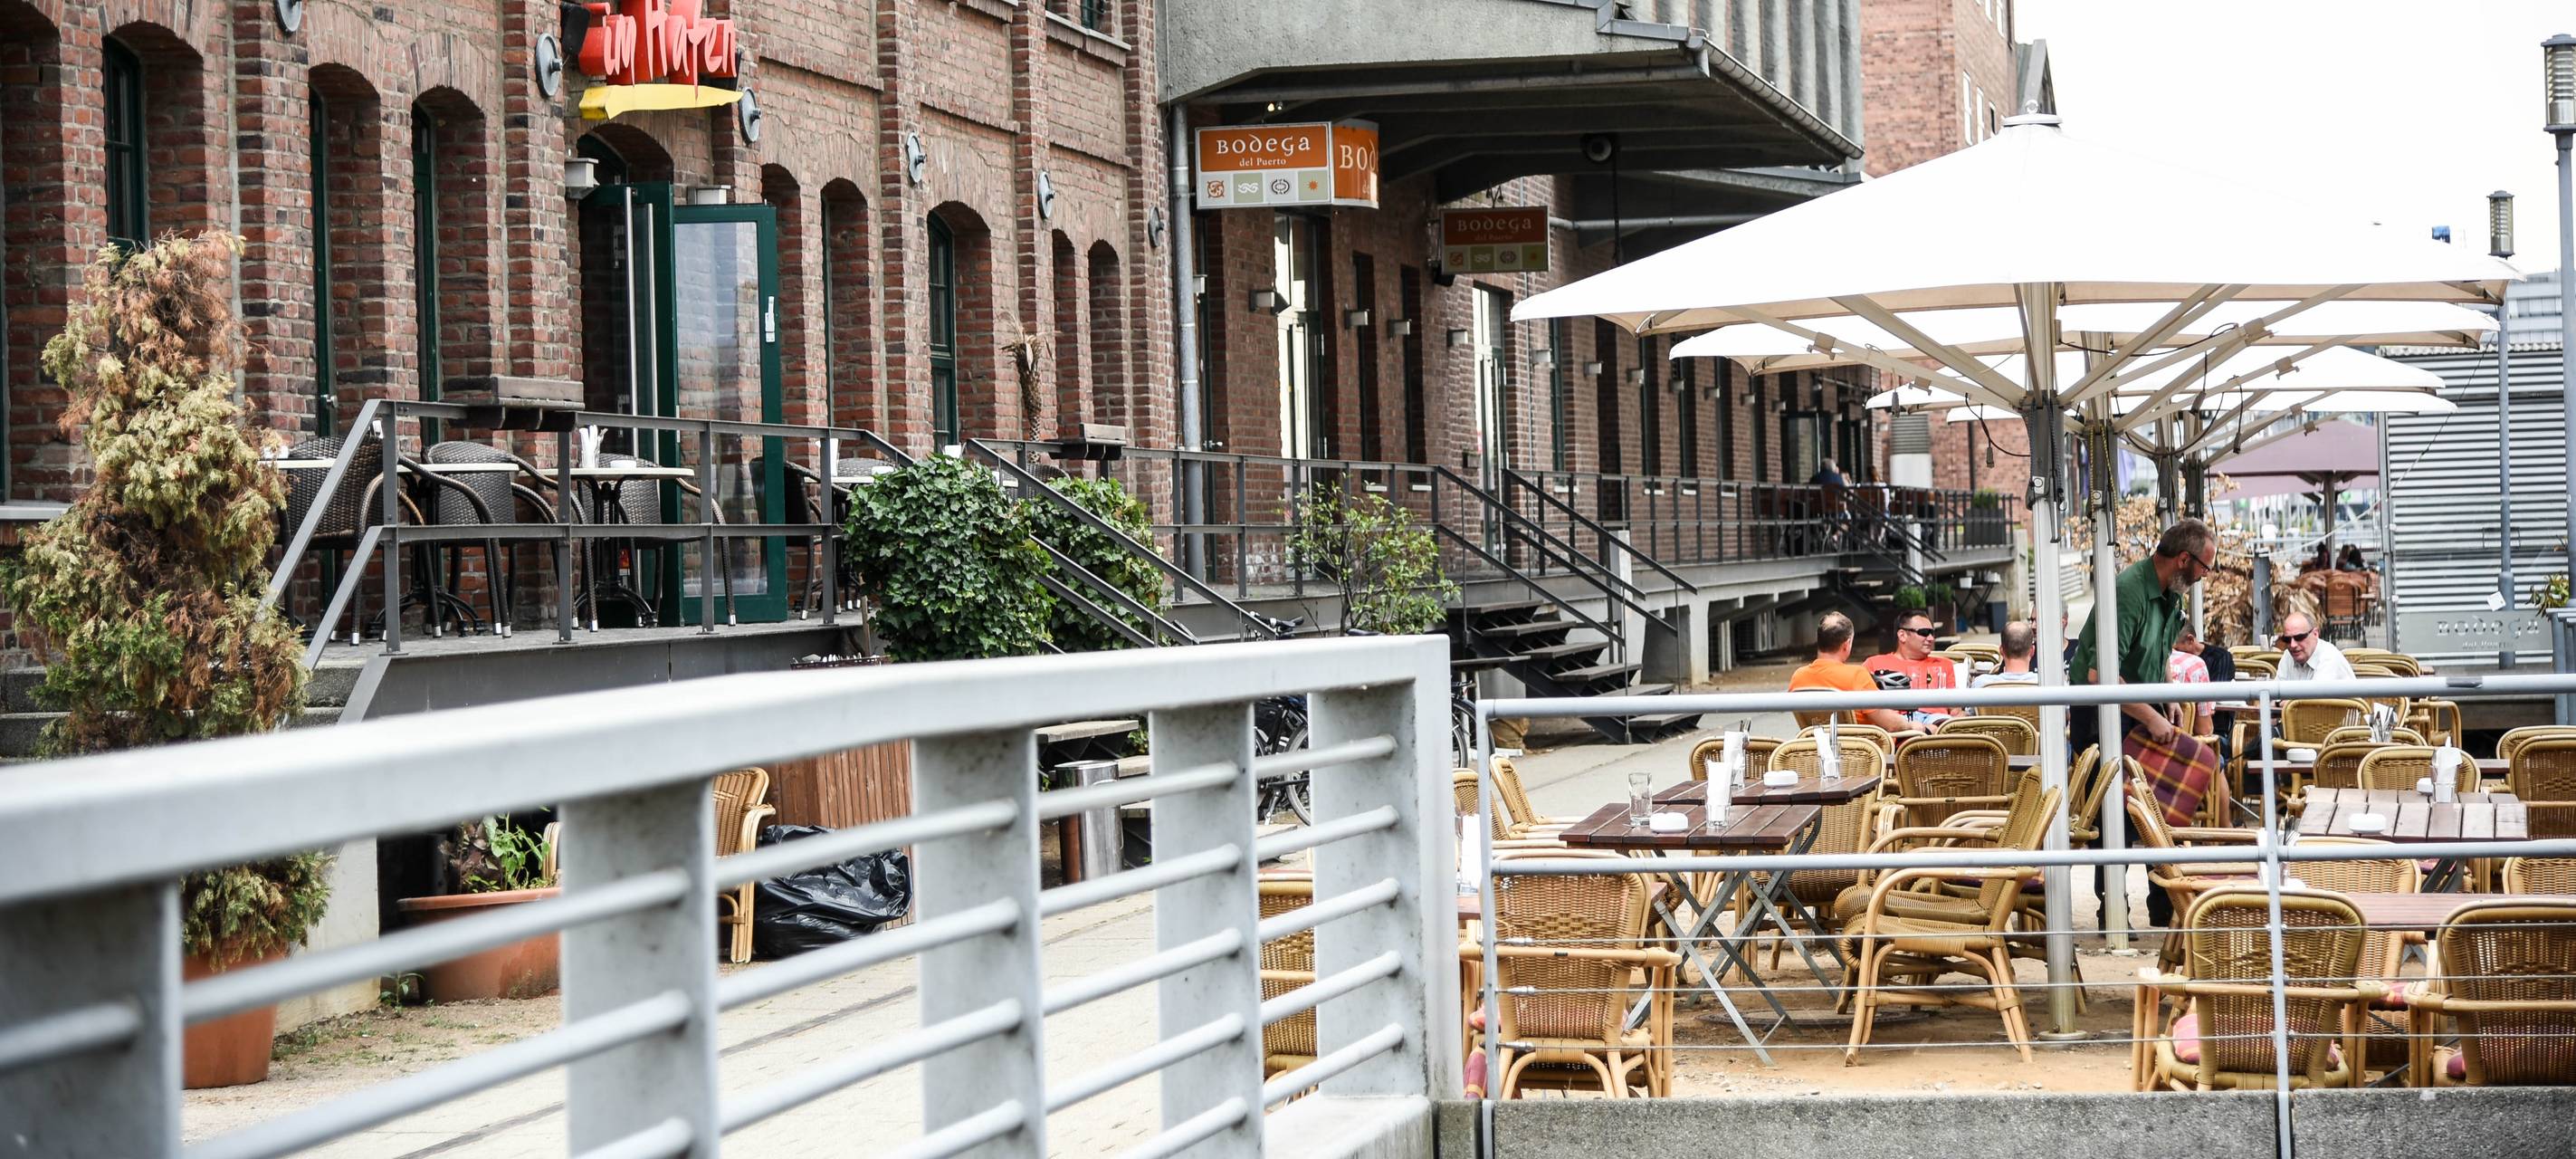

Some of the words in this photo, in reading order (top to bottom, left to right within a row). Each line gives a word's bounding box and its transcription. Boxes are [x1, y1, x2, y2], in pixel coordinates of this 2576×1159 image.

[603, 3, 636, 87] im
[644, 0, 738, 101] Hafen
[1216, 134, 1311, 157] Bodega
[1340, 138, 1379, 171] Bod
[1239, 158, 1253, 167] del
[1256, 157, 1286, 166] Puerto
[1456, 216, 1531, 234] Bodega
[2437, 615, 2540, 638] Bodega
